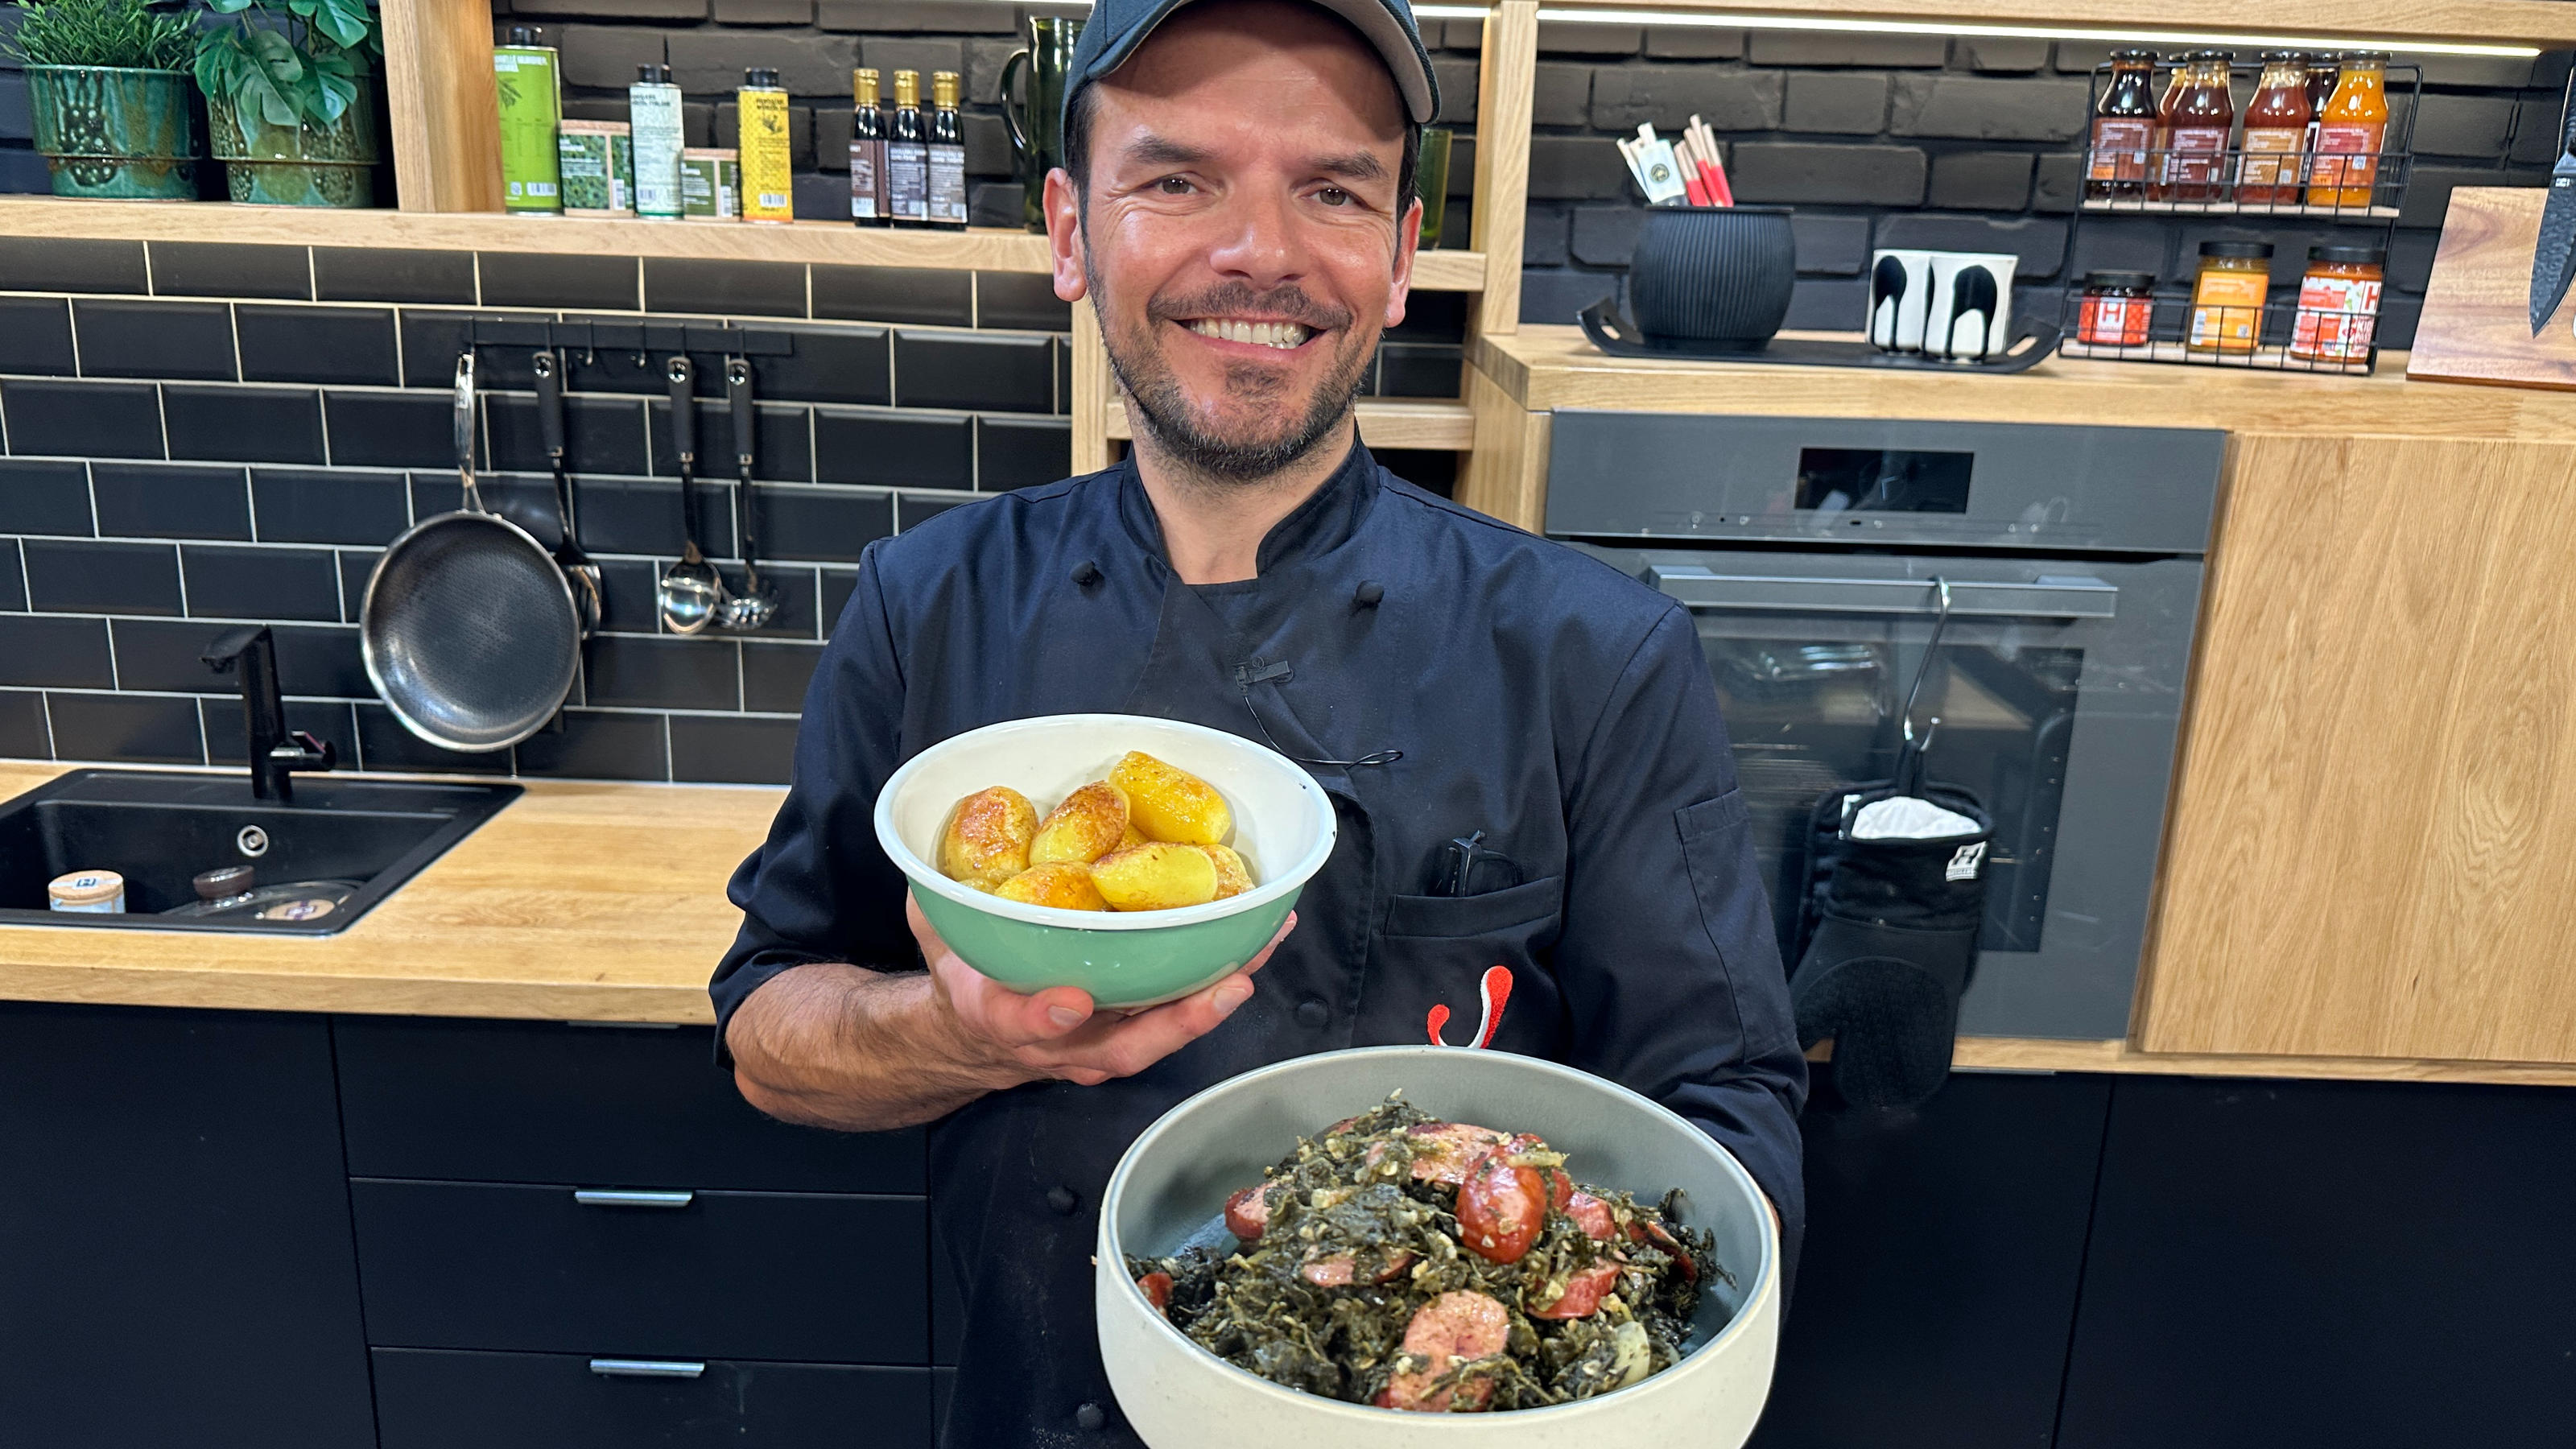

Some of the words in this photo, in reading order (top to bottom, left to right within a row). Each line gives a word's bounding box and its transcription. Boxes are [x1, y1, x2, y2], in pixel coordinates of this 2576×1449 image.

[2365, 285, 2380, 310] H
[2102, 301, 2121, 323] H
[1951, 847, 1980, 865] H
